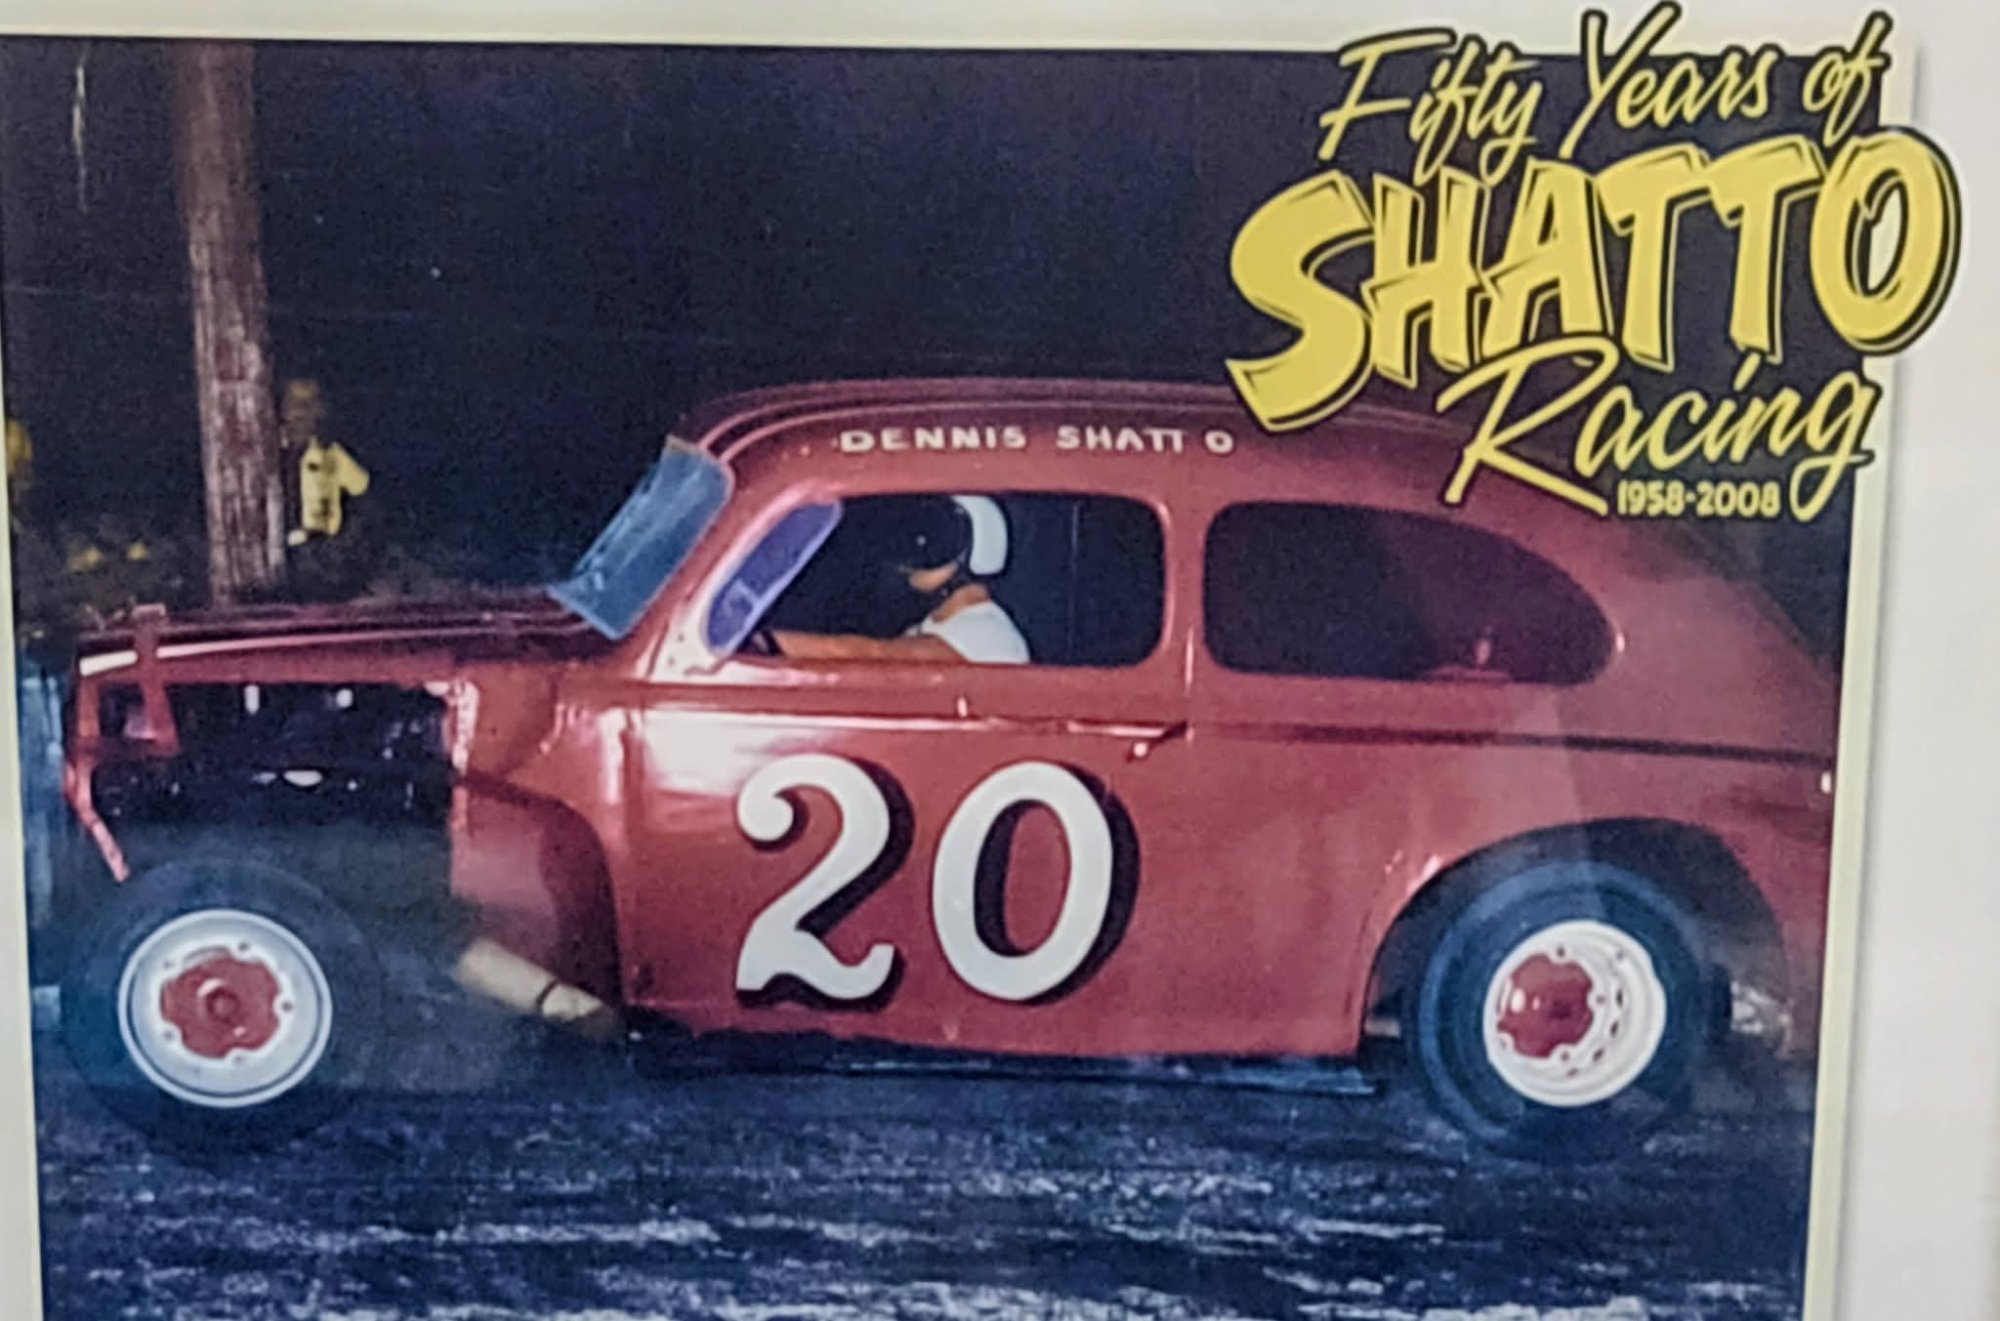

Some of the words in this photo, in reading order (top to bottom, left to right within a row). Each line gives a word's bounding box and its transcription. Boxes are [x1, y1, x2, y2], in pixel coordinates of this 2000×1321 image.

[1318, 30, 1543, 184] Fifty
[1558, 3, 1778, 158] Years
[1802, 14, 1890, 146] of
[1226, 128, 1958, 432] SHATTO
[839, 426, 1027, 452] DENNIS
[1436, 334, 1875, 520] Racing
[735, 752, 1136, 1006] 20
